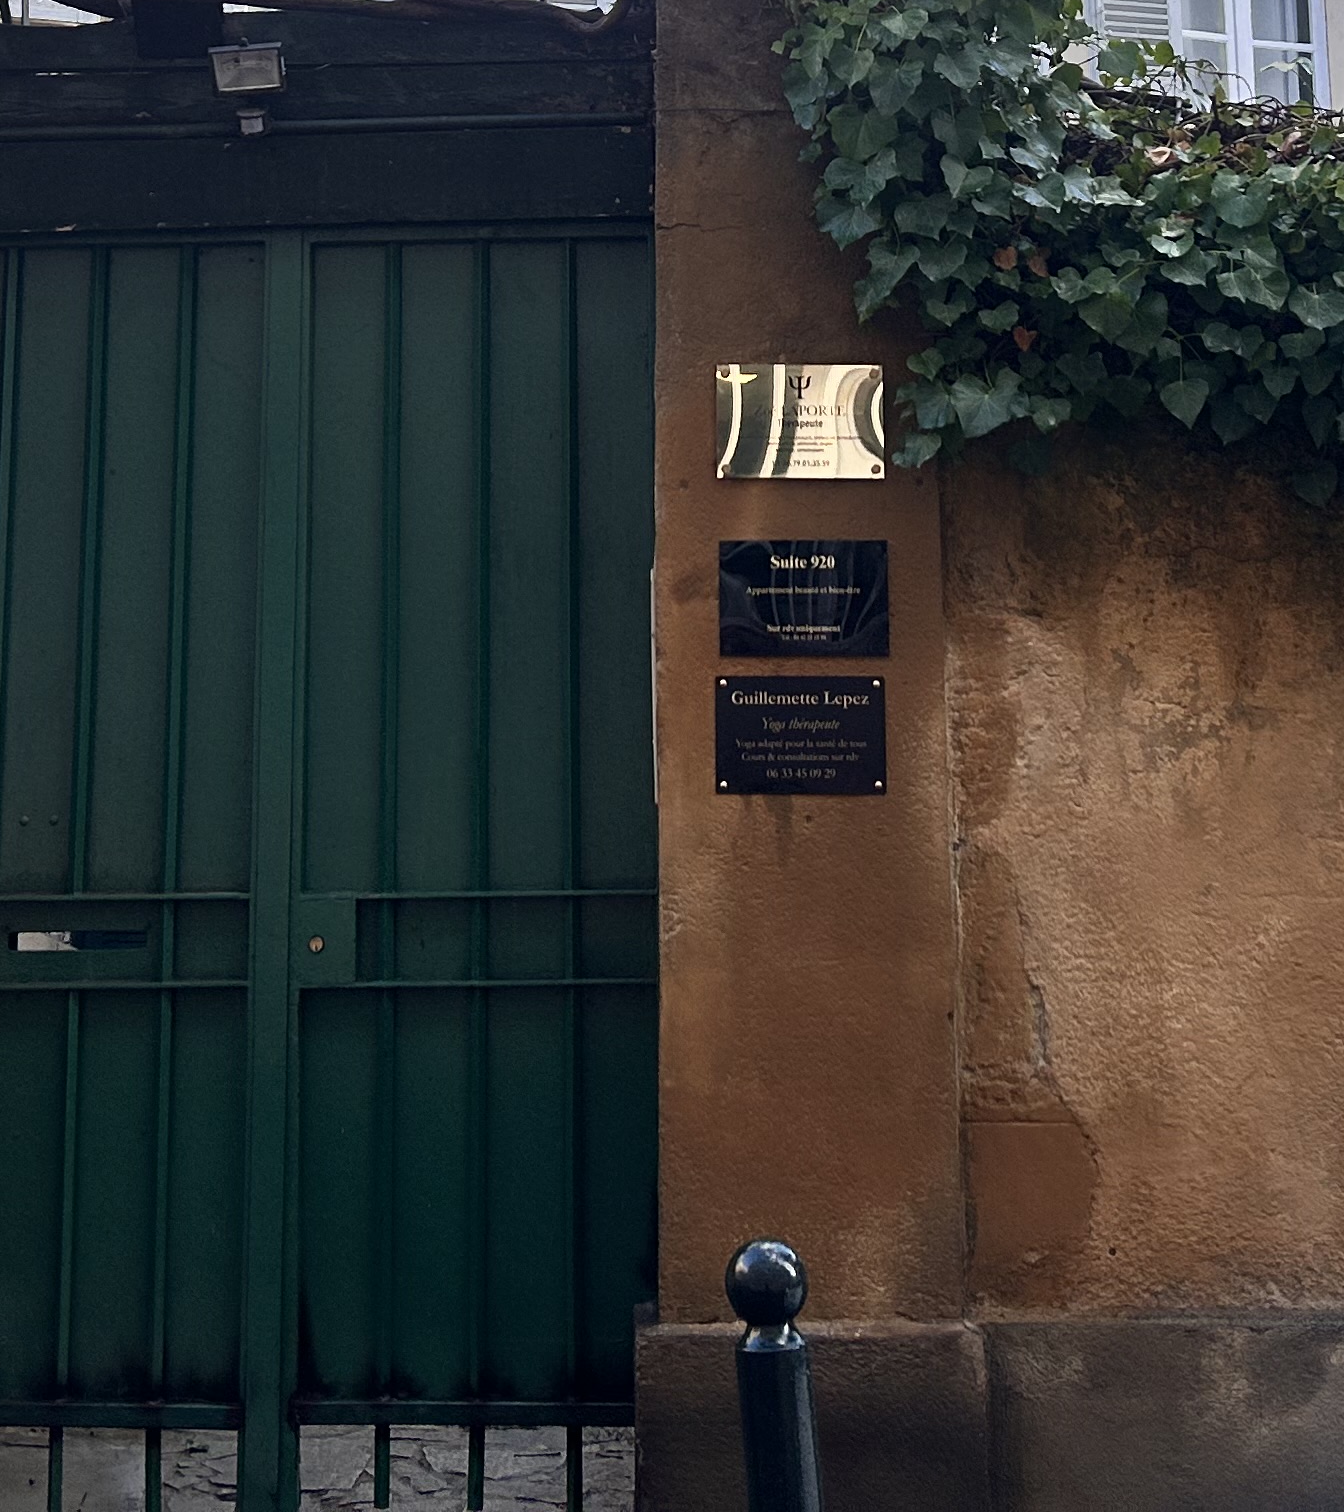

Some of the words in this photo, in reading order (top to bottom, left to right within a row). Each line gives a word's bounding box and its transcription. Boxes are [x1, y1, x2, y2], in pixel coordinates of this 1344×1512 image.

[770, 555, 807, 569] Suite
[810, 555, 835, 569] 920
[731, 690, 819, 705] Guillemette
[823, 690, 870, 709] Lepez
[762, 717, 785, 732] Yoga
[789, 717, 840, 733] thérapeute
[736, 739, 755, 749] Yoga
[766, 768, 779, 778] 06
[781, 768, 793, 778] 33
